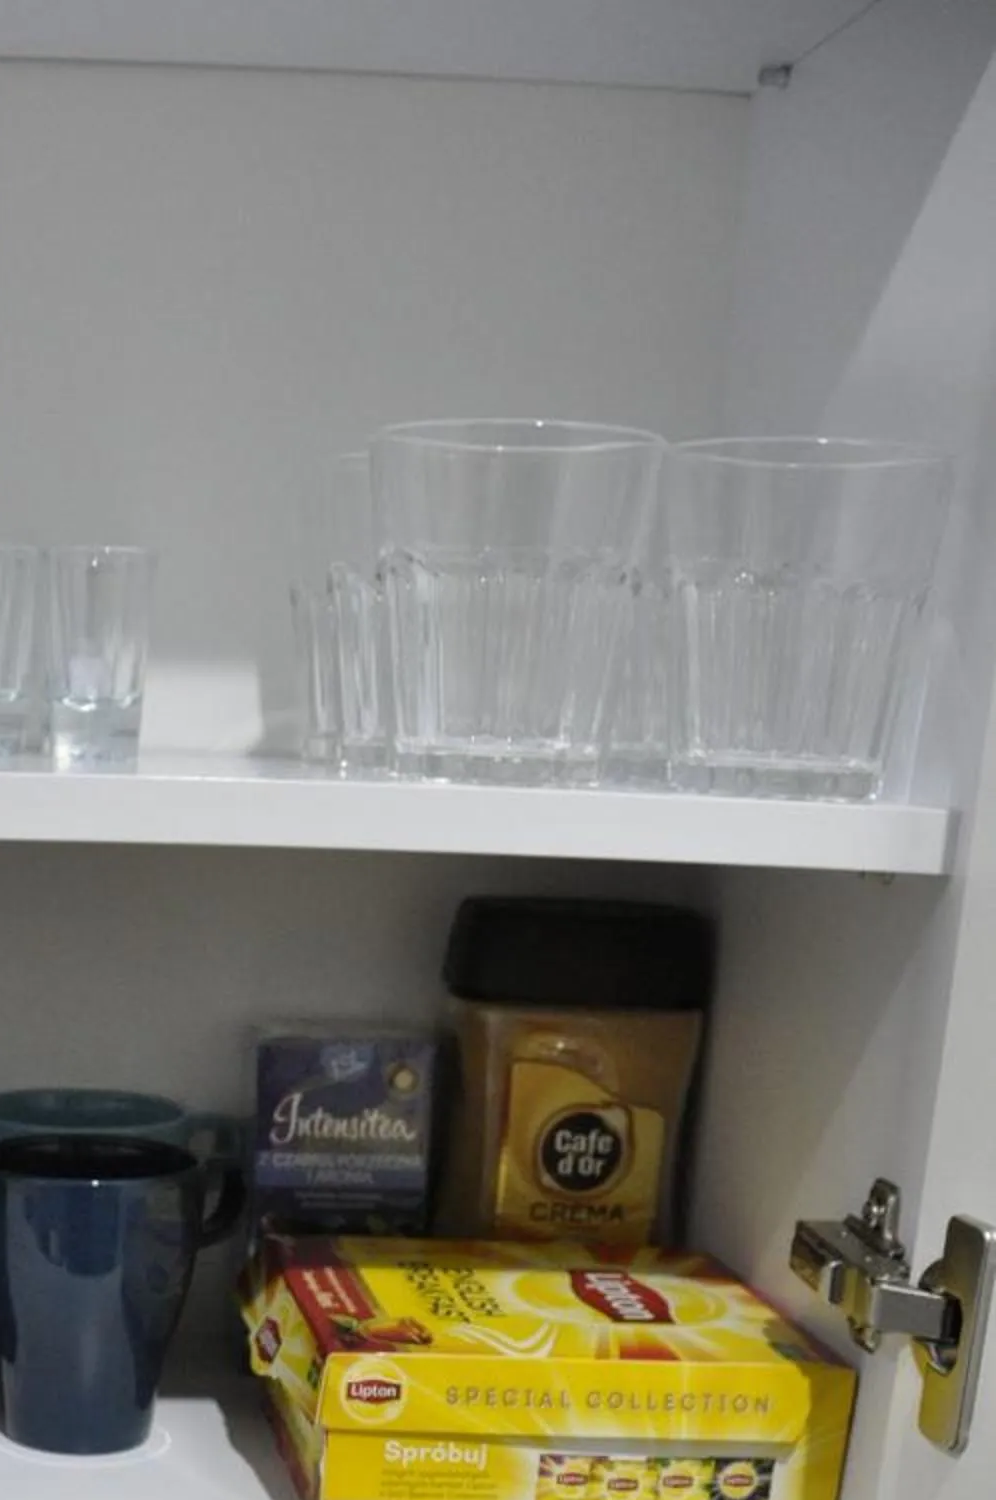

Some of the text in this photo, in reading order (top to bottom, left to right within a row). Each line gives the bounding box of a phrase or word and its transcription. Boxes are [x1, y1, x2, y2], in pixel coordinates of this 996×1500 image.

[554, 1128, 615, 1156] Cafe
[350, 1383, 398, 1401] Lipton
[445, 1385, 772, 1414] SPECIAL COLLECTION
[383, 1440, 489, 1471] Spróbuj
